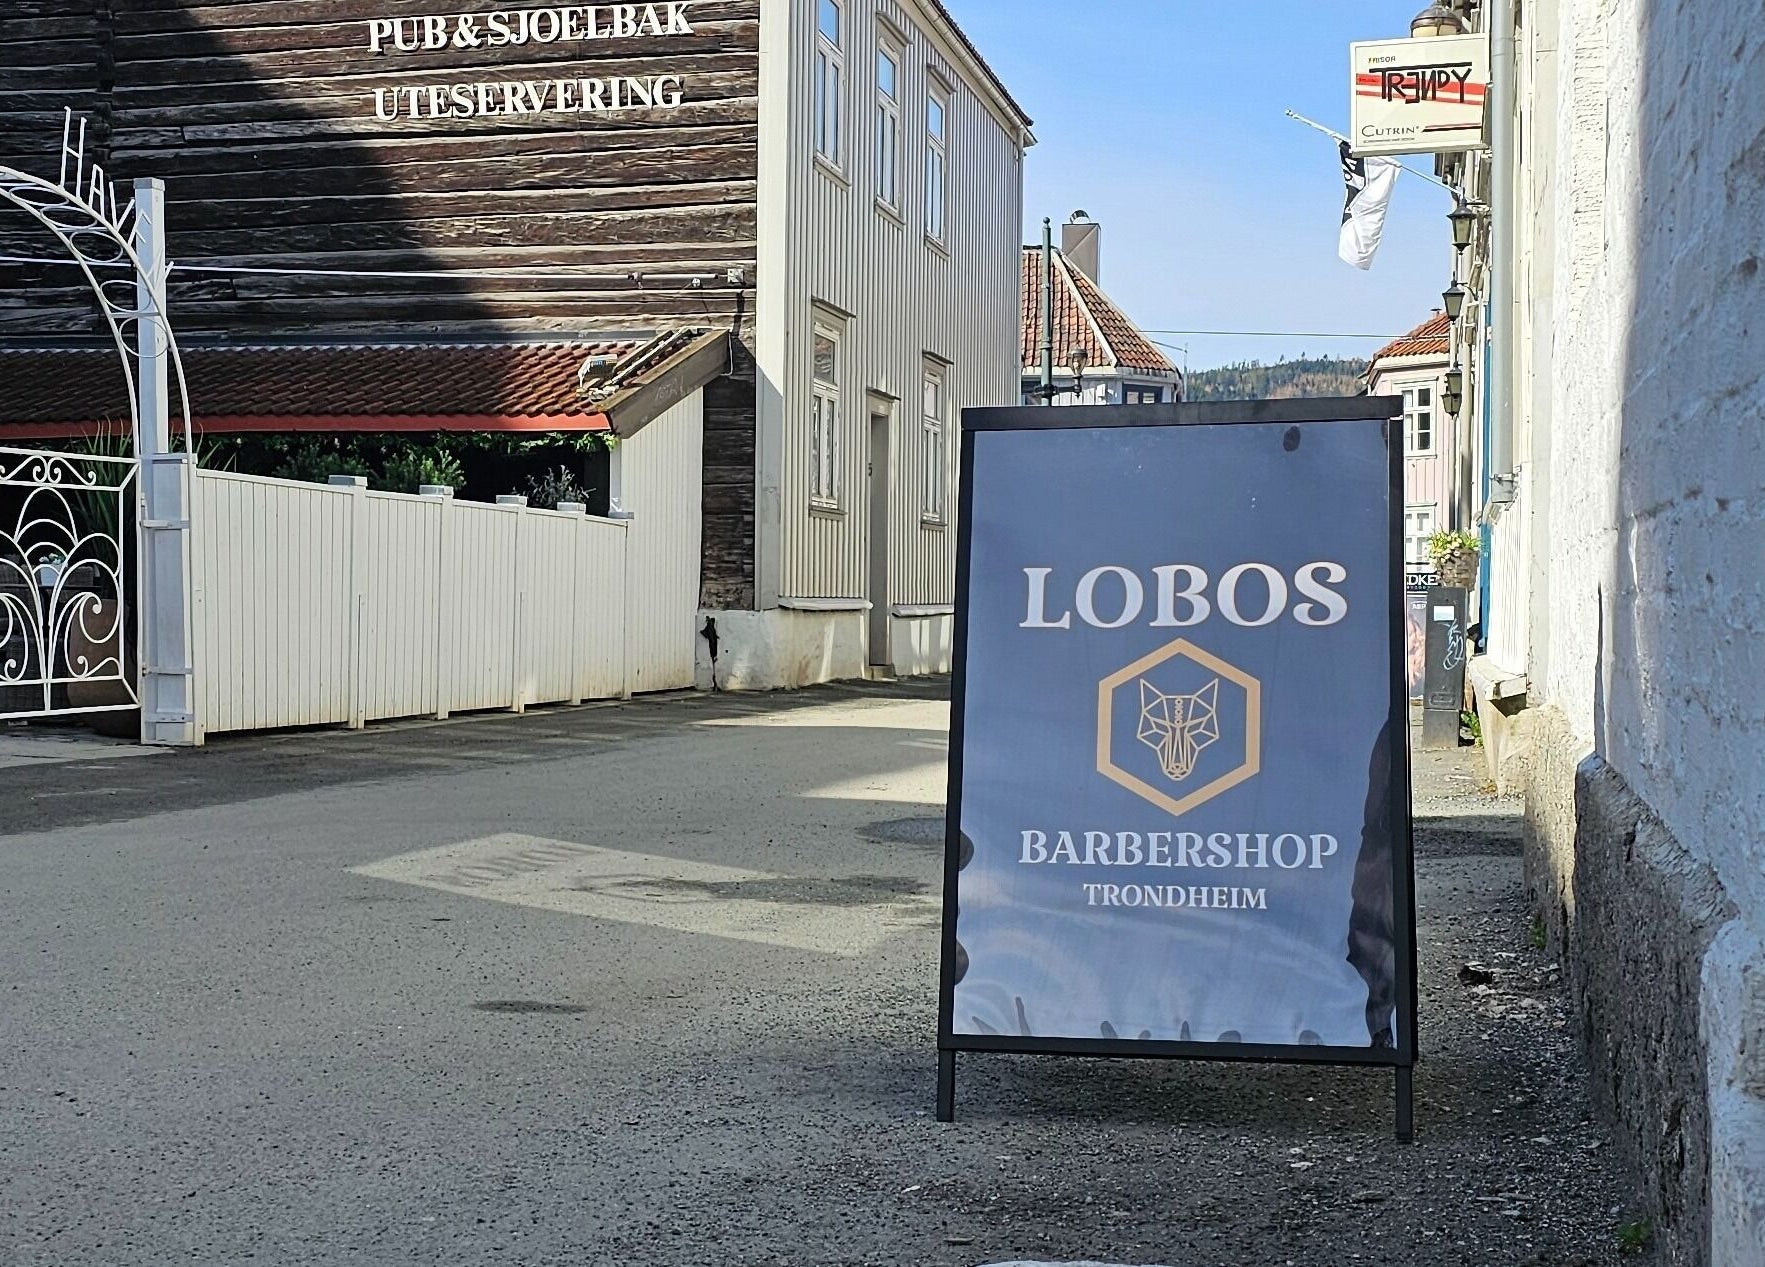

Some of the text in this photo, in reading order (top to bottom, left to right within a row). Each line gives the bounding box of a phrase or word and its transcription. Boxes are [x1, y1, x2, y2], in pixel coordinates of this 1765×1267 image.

[372, 75, 684, 121] UTESERVERING
[1019, 561, 1348, 630] LOBOS
[1018, 830, 1338, 869] BARBERSHOP
[1083, 883, 1268, 910] TRONDHEIM
